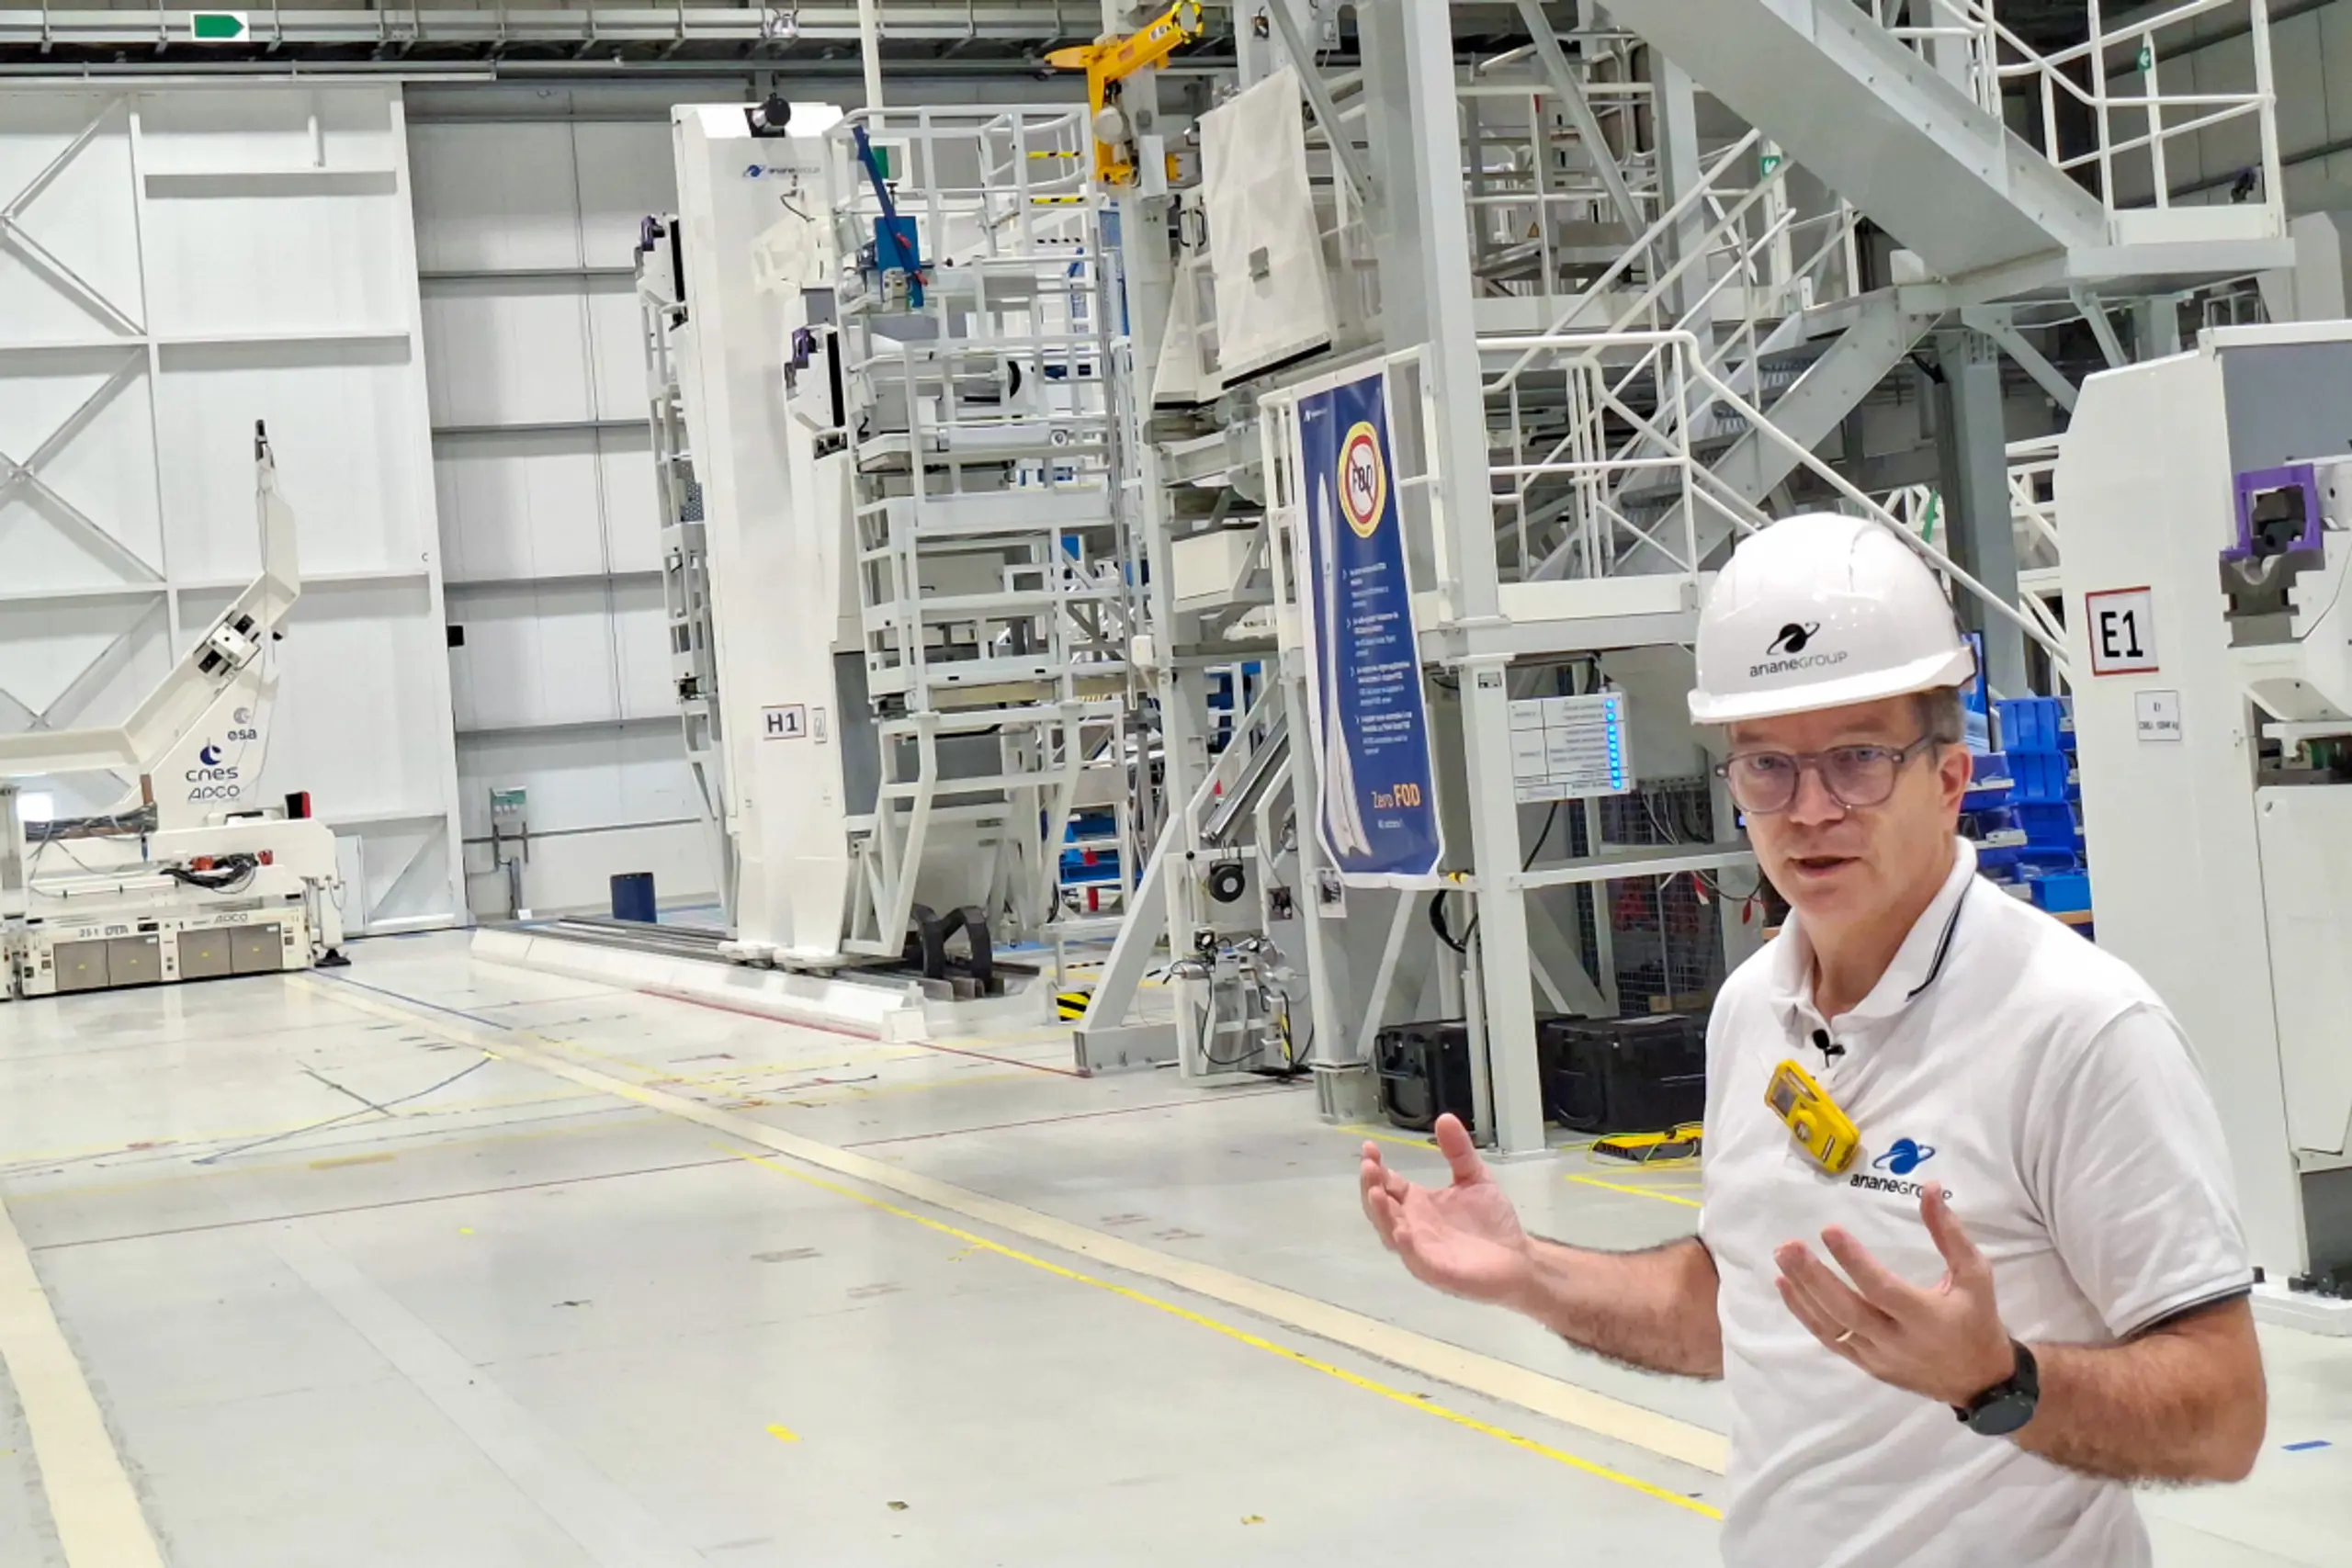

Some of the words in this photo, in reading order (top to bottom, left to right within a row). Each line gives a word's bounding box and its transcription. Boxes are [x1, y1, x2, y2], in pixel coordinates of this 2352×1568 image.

[2100, 610, 2143, 658] E1
[767, 712, 798, 733] H1
[227, 728, 257, 741] esa
[186, 766, 239, 783] cnes
[1371, 791, 1394, 808] Zero
[1393, 784, 1420, 807] FOD
